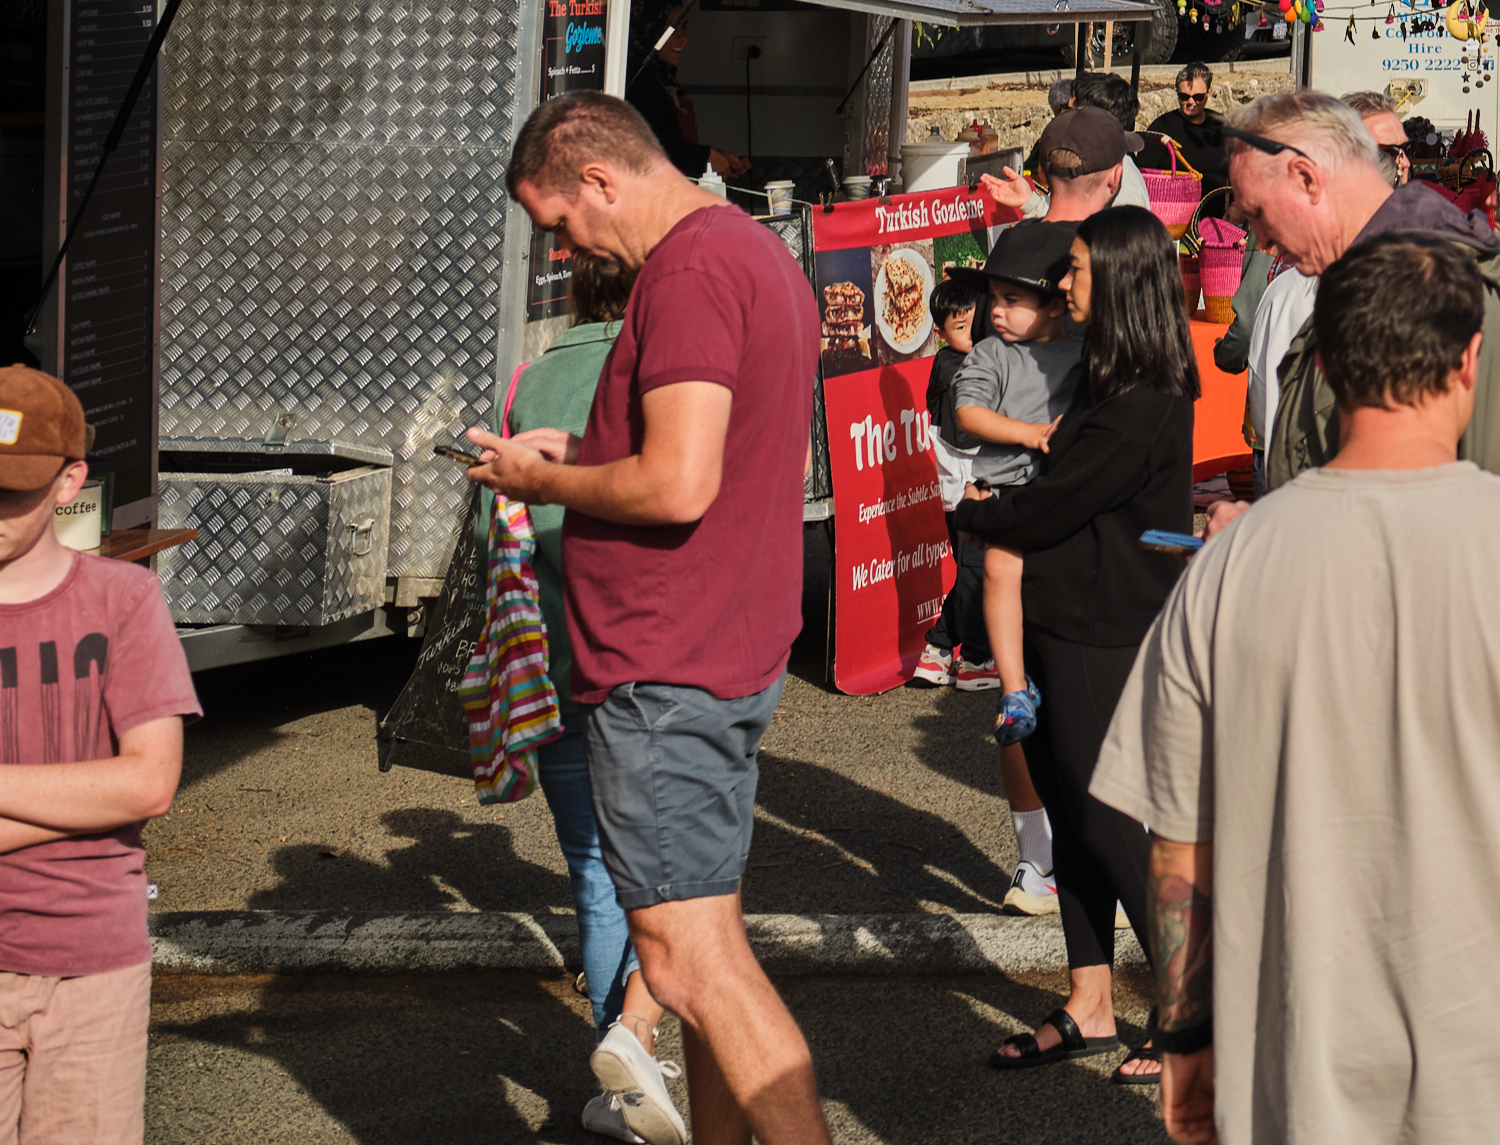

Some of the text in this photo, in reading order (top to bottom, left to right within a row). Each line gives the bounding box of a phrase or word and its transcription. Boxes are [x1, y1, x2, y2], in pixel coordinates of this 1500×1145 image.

[549, 0, 567, 17] The
[1397, 12, 1446, 23] Mobie
[565, 21, 602, 53] Gozleme
[1408, 43, 1442, 54] Hire
[548, 66, 565, 78] Spinach
[1382, 59, 1461, 71] 9250 2222
[875, 195, 984, 234] Turkish Gozleme
[850, 414, 897, 471] The
[55, 501, 97, 516] coffee
[858, 497, 896, 524] Experience
[896, 492, 907, 509] the
[907, 484, 929, 507] Subtle
[852, 539, 949, 591] We Cater for all types
[419, 611, 472, 670] Turkish
